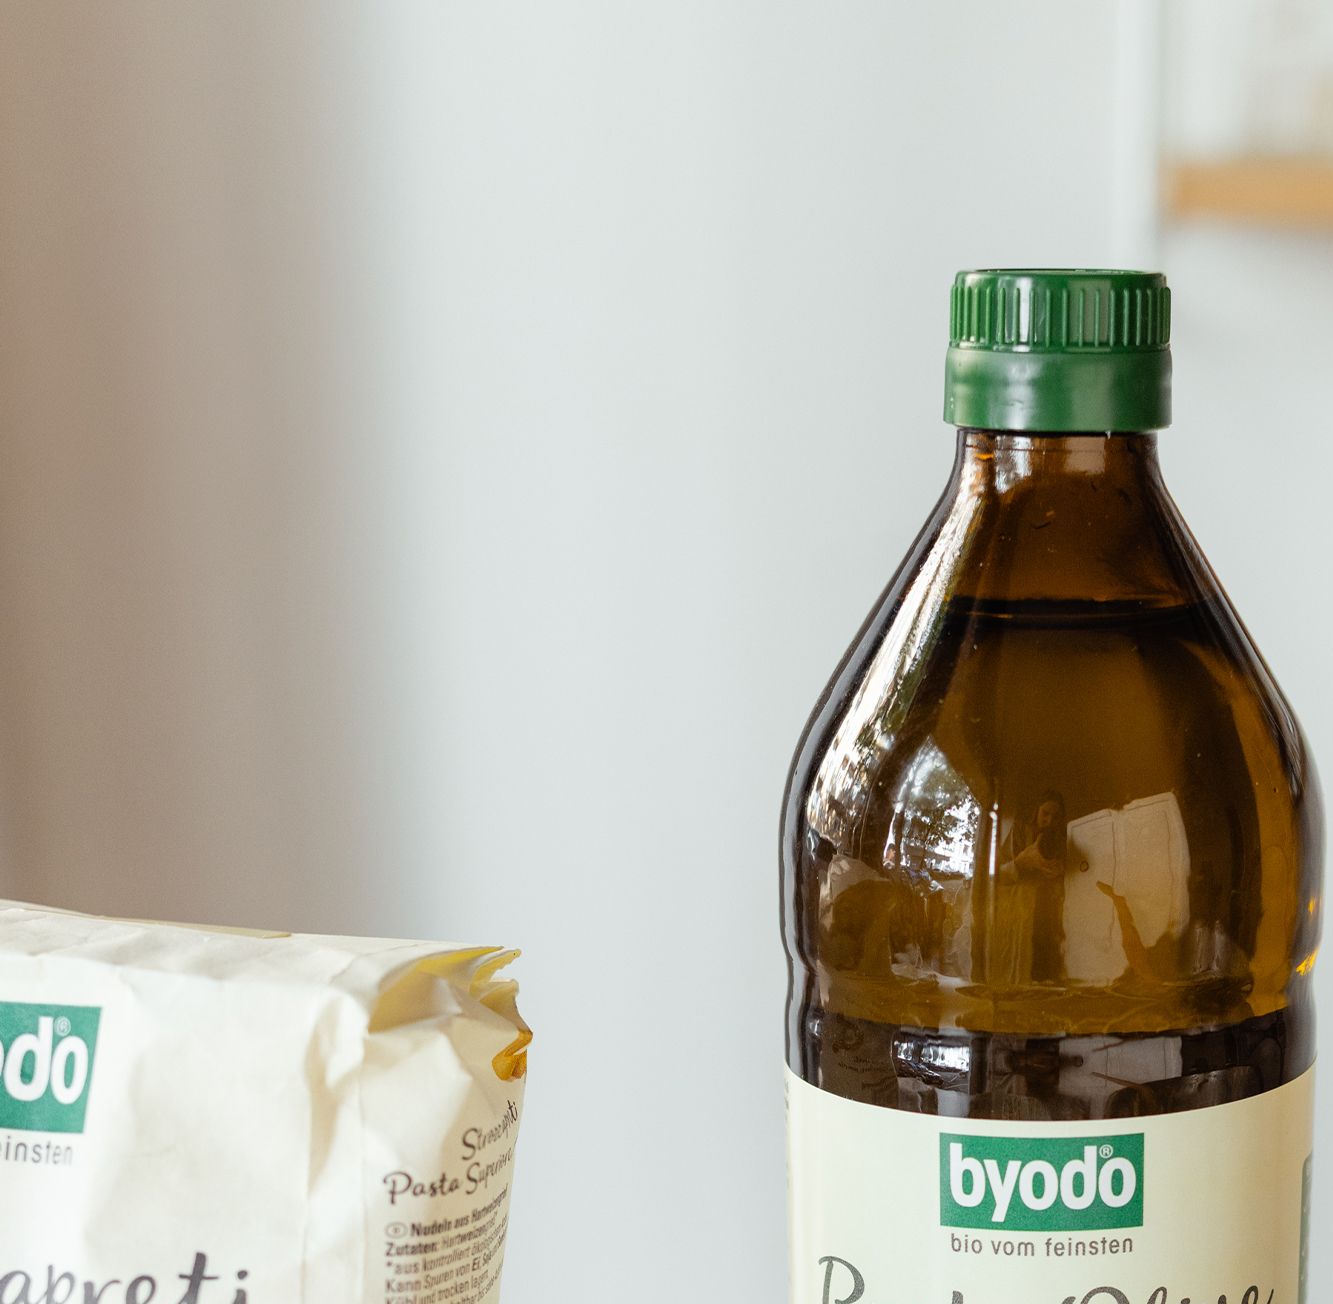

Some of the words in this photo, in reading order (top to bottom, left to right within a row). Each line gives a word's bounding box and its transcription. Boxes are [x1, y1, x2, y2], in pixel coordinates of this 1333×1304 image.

[0, 1135, 73, 1166] insten
[383, 1171, 459, 1205] Pasta
[411, 1217, 451, 1237] Nudeln
[454, 1214, 470, 1229] aus
[386, 1240, 438, 1257] Zutaten:
[950, 1232, 983, 1255] bio
[991, 1238, 1035, 1257] vom
[1045, 1236, 1134, 1257] feinsten
[424, 1248, 470, 1272] kontrolliert
[386, 1279, 422, 1293] Kann
[424, 1270, 454, 1289] Spuren
[456, 1263, 470, 1277] von
[438, 1280, 470, 1299] trocken
